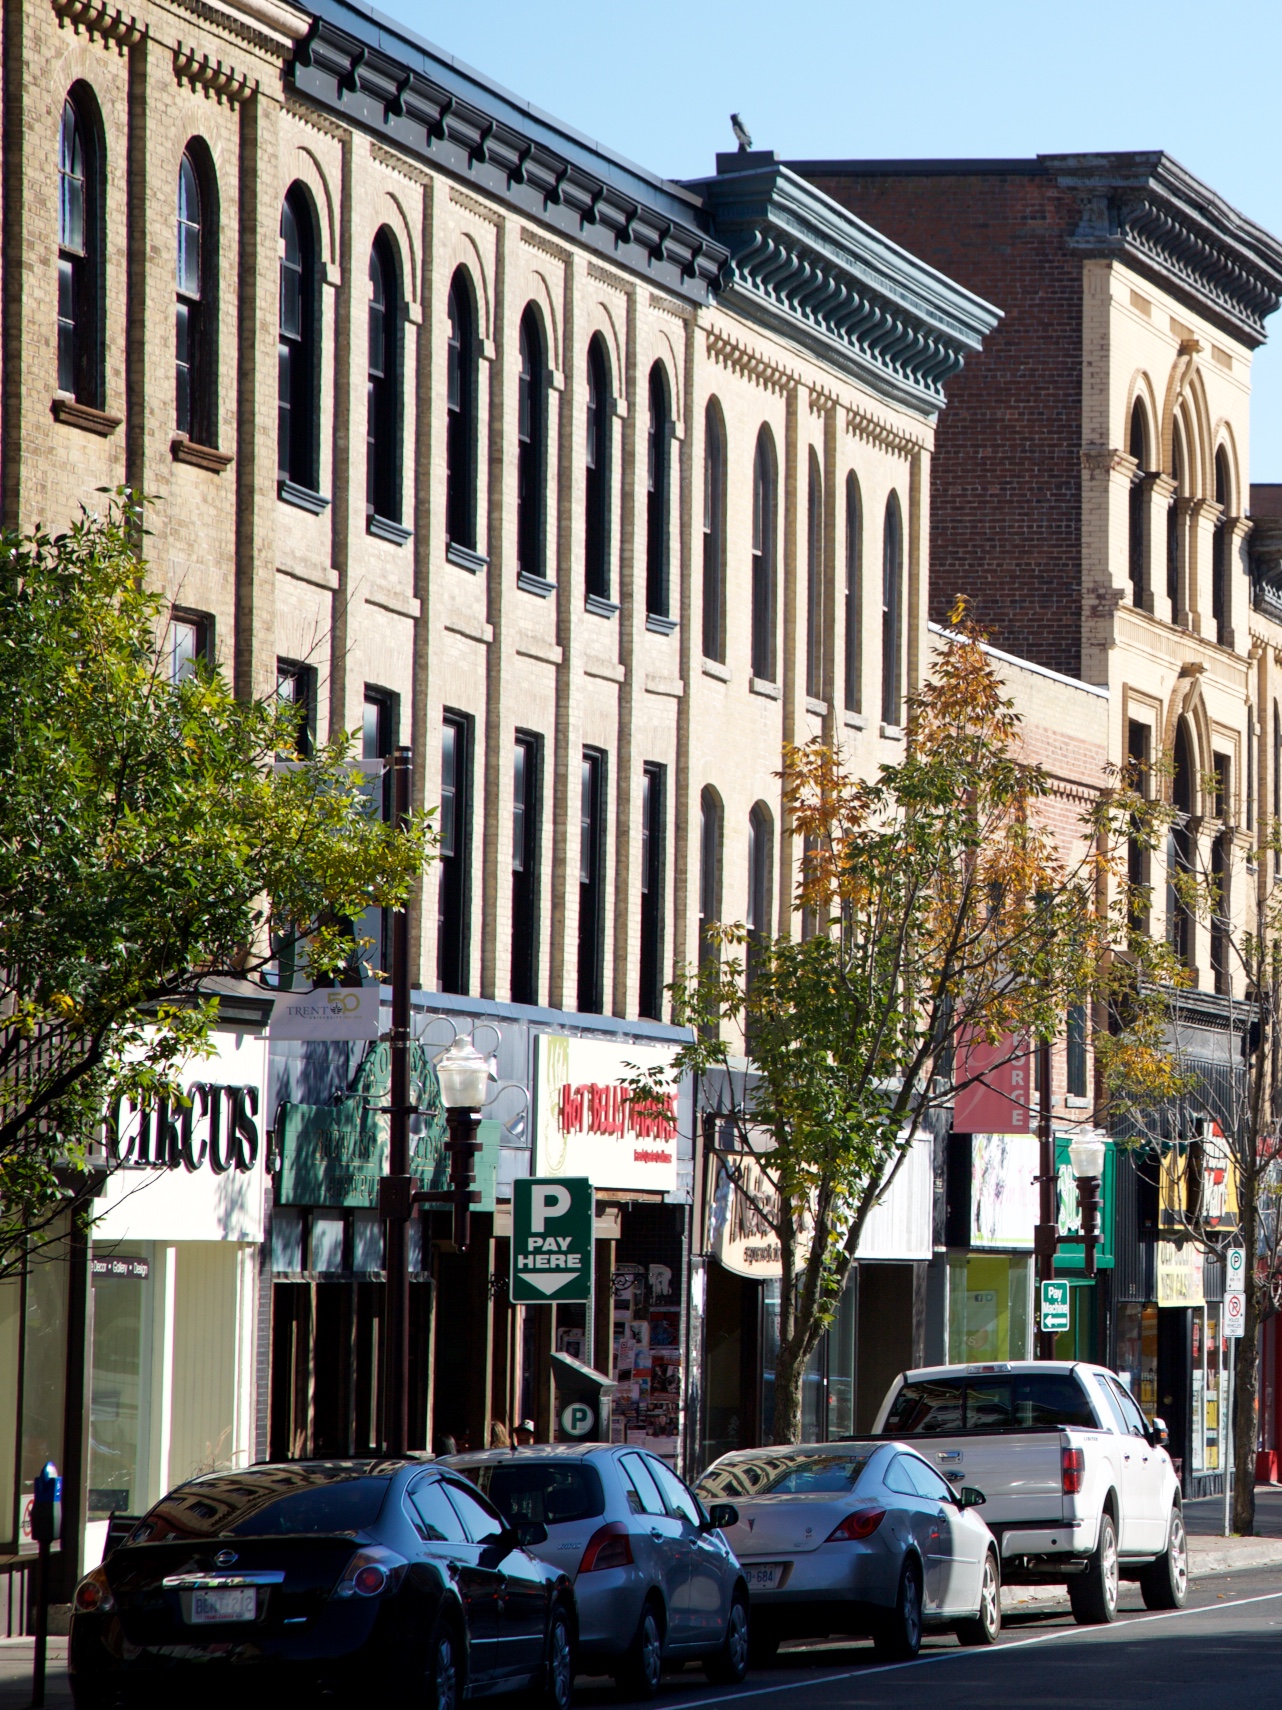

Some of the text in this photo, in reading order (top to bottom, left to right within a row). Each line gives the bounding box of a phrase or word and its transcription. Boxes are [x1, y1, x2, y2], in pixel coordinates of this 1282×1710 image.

[286, 1005, 329, 1018] TRENT
[1011, 1022, 1025, 1126] EORGE
[106, 1080, 259, 1176] CIRCUS
[531, 1184, 572, 1233] P
[527, 1236, 573, 1252] PAY
[517, 1253, 582, 1269] HERE
[1047, 1286, 1063, 1302] Pay
[1043, 1301, 1068, 1314] Machine
[757, 1570, 774, 1583] 684
